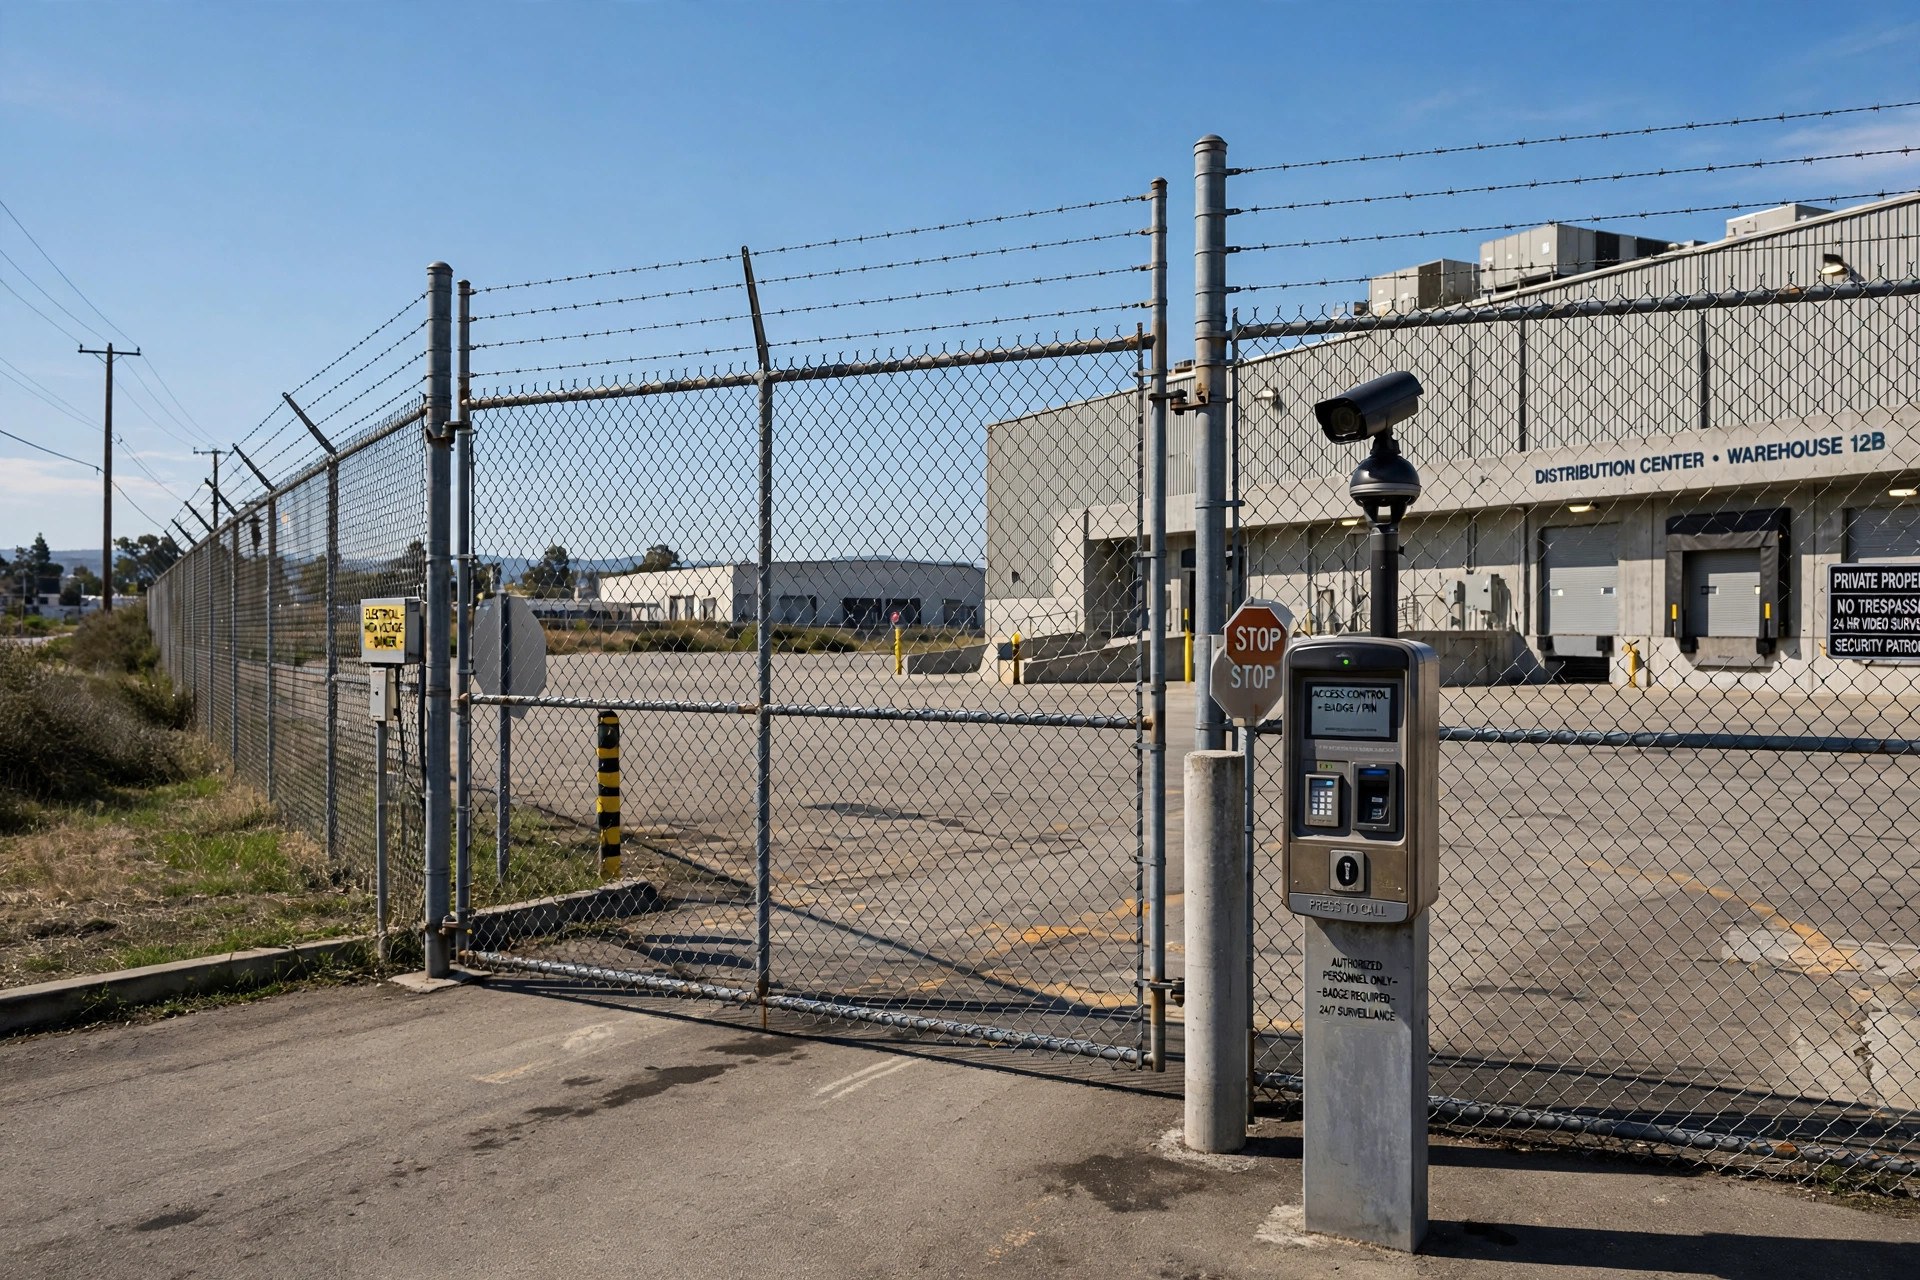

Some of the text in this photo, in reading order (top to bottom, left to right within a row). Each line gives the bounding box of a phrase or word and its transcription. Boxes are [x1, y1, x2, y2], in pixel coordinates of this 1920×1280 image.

[1535, 431, 1886, 484] DISTRIBUTION CENTER WAREHOUSE 12B
[1833, 572, 1920, 589] PRIVATE PROPE
[1837, 598, 1855, 615] NO
[1832, 617, 1845, 631] 24
[1846, 616, 1860, 630] HR
[1861, 617, 1889, 631] VIDEO
[1235, 625, 1282, 652] STOP
[1834, 637, 1883, 653] SECURITY
[1230, 664, 1276, 689] STOP
[1347, 689, 1389, 700] CONTROL
[1310, 899, 1387, 918] PRESS TO CALL
[1331, 957, 1383, 971] AUTHORIZED
[1322, 970, 1369, 985] PERSONNEL
[1319, 1004, 1336, 1016] 24/7
